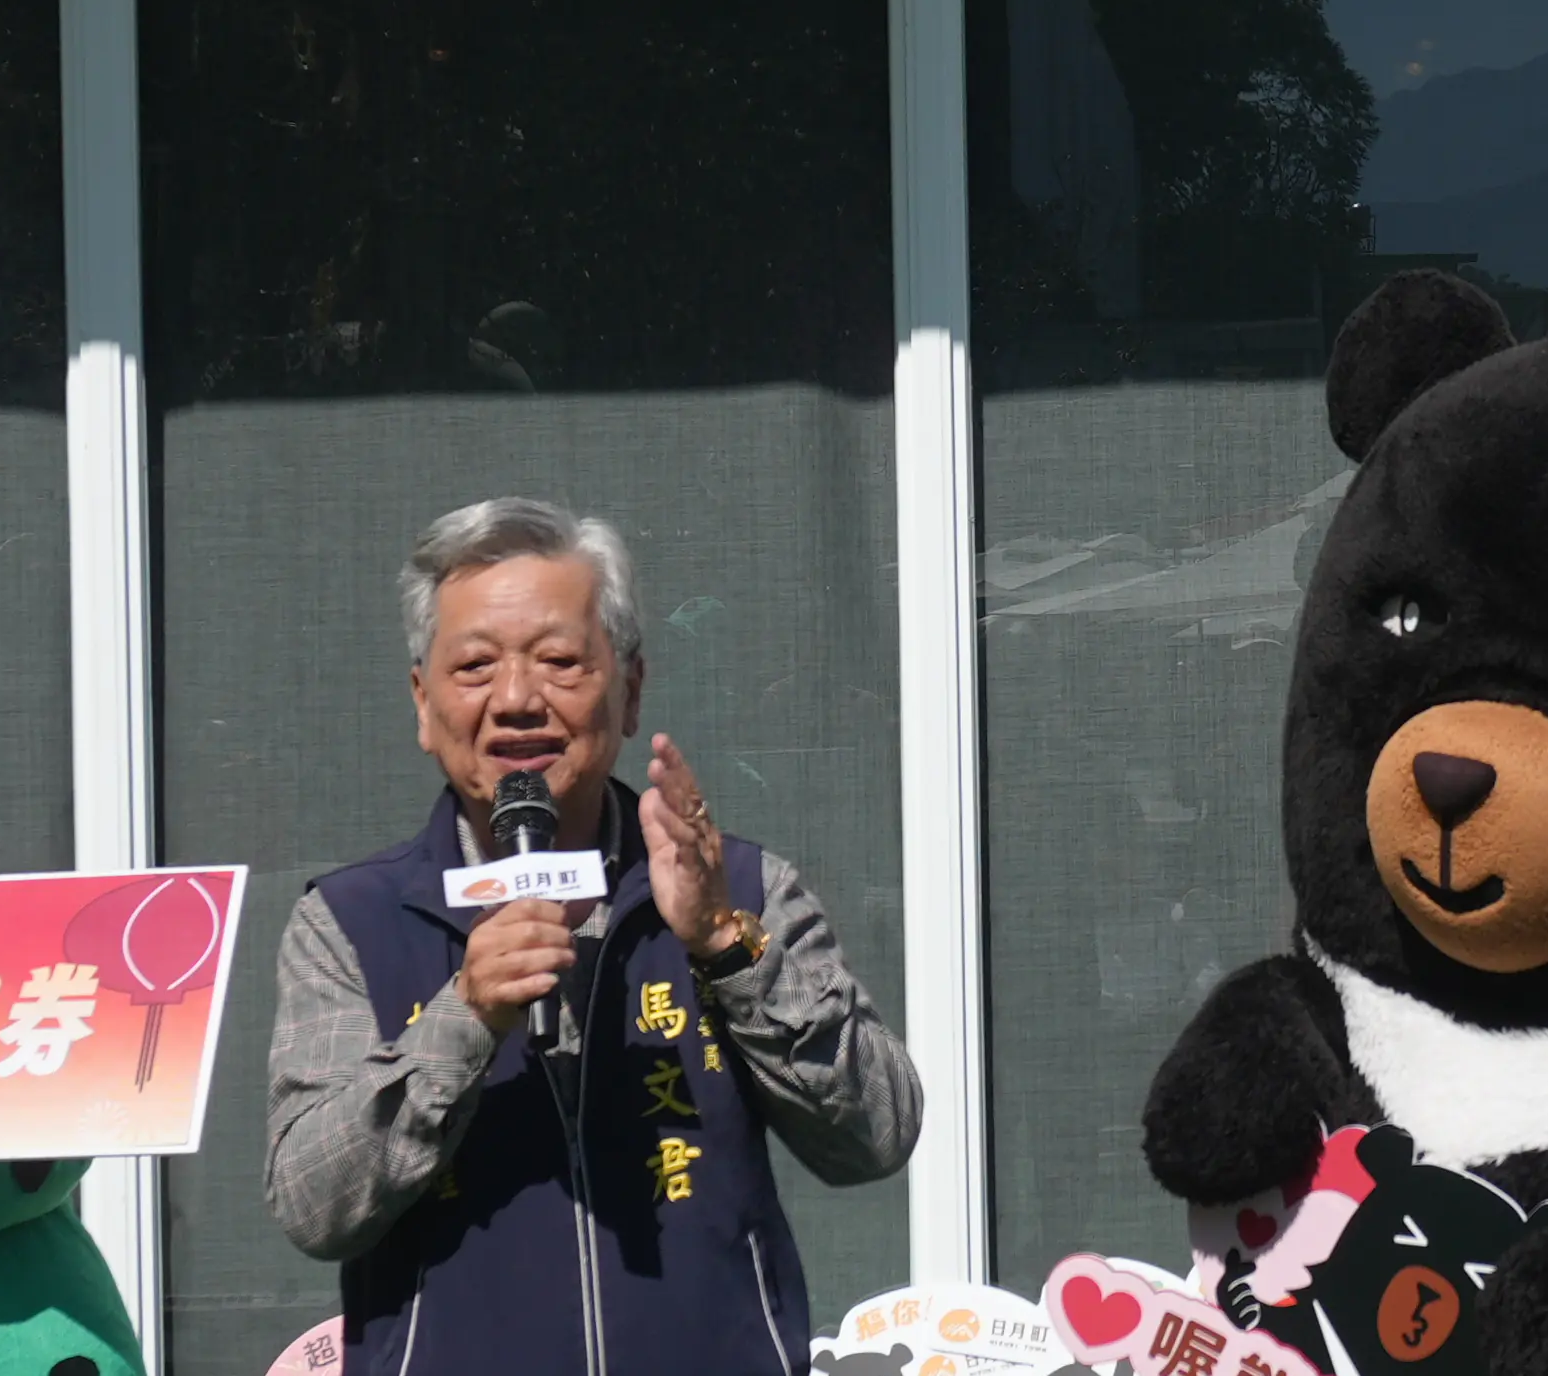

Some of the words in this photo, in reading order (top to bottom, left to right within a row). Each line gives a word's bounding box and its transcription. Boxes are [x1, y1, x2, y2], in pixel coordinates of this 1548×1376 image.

[515, 870, 578, 891] 日月町
[990, 1318, 1051, 1344] 日月町
[303, 1333, 339, 1372] 超
